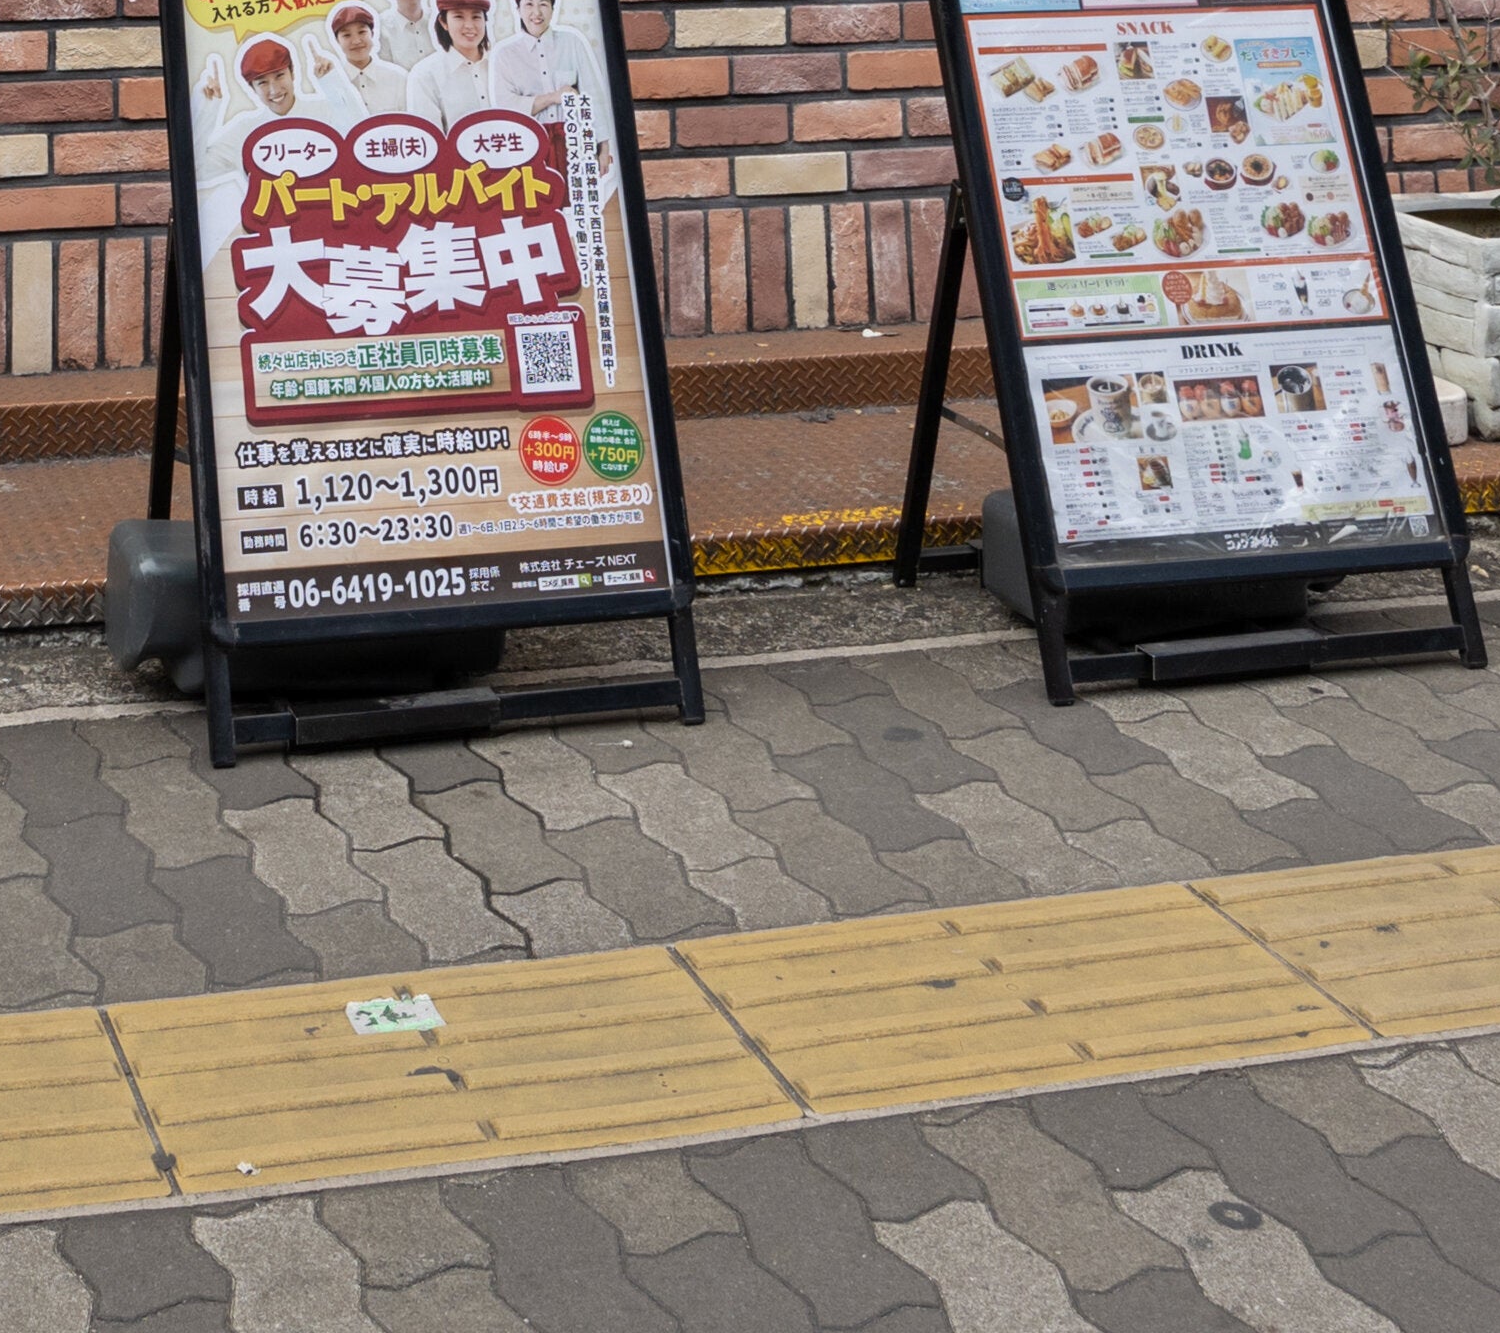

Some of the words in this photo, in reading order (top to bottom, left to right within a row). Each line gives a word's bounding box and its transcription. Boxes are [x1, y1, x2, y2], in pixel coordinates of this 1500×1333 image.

[1116, 20, 1175, 36] SNACK
[1239, 47, 1315, 62] だいすきプレート
[258, 142, 332, 162] フリーター
[365, 136, 427, 159] 主婦(夫)
[473, 132, 524, 154] 大学生
[253, 160, 551, 226] パート・アルバイト
[242, 215, 566, 335] 大募集中
[257, 336, 504, 371] 続々出店中につき正社員同時募集
[1180, 342, 1244, 361] DRINK
[271, 377, 357, 399] 年齢・国籍不問
[359, 369, 491, 394] 外国人の方も大活躍中!
[236, 427, 510, 468] 仕事を覚えるほどに確実に時給UP!
[524, 442, 575, 461] +300円
[588, 446, 639, 464] +750円
[532, 460, 569, 473] 時給UP
[243, 487, 278, 506] 時給
[243, 532, 286, 550] 勤務時間
[519, 559, 561, 573] 株式会社
[564, 555, 605, 571] チェーズ
[607, 553, 637, 566] NEXT
[468, 566, 501, 580] 採用係
[288, 567, 467, 609] 06-6419-1025
[470, 581, 496, 593] まで。
